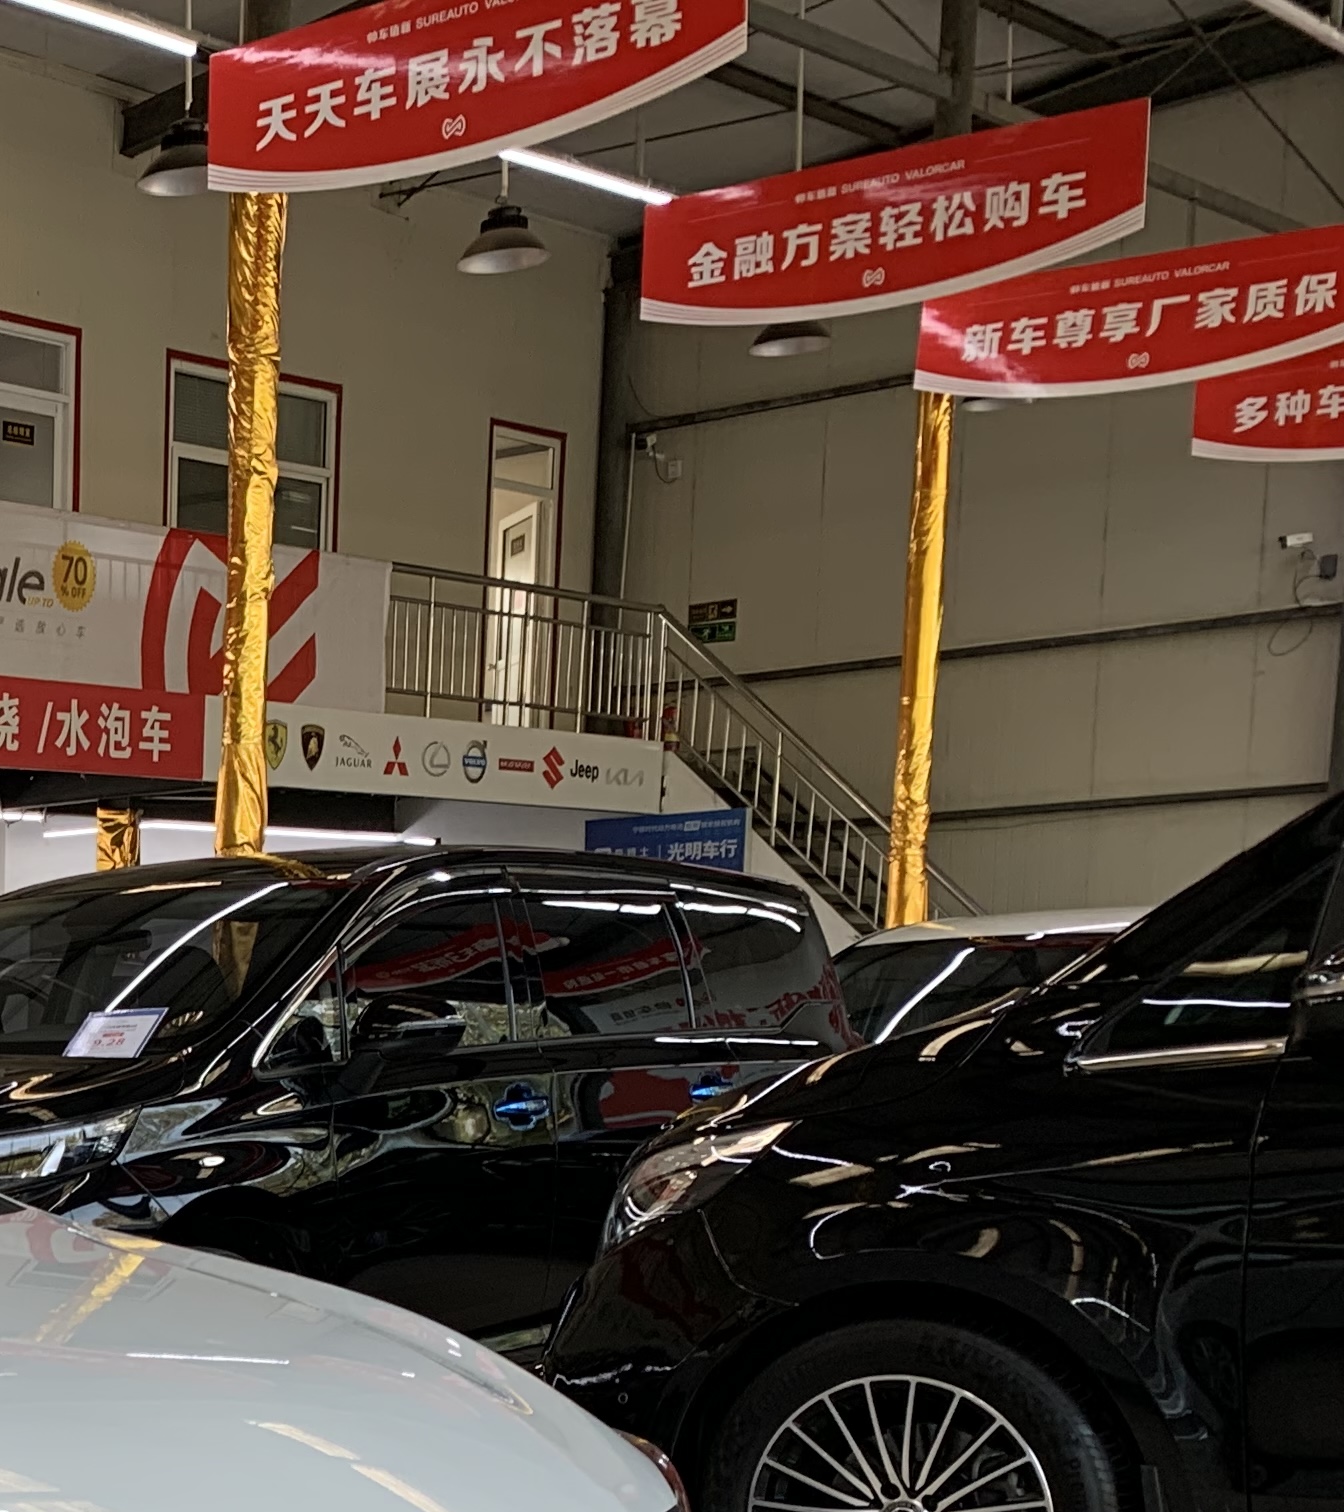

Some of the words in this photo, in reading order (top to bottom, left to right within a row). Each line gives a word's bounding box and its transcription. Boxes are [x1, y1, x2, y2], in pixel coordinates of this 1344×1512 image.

[415, 1, 479, 29] SUREAUTO
[255, 0, 683, 152] 天天车展永不落幕
[687, 170, 1088, 290] 金融方案轻松购车
[962, 270, 1339, 364] 新车尊享厂家质保
[61, 554, 88, 586] 70
[335, 756, 373, 769] JAGUAR
[570, 759, 600, 783] Jeep
